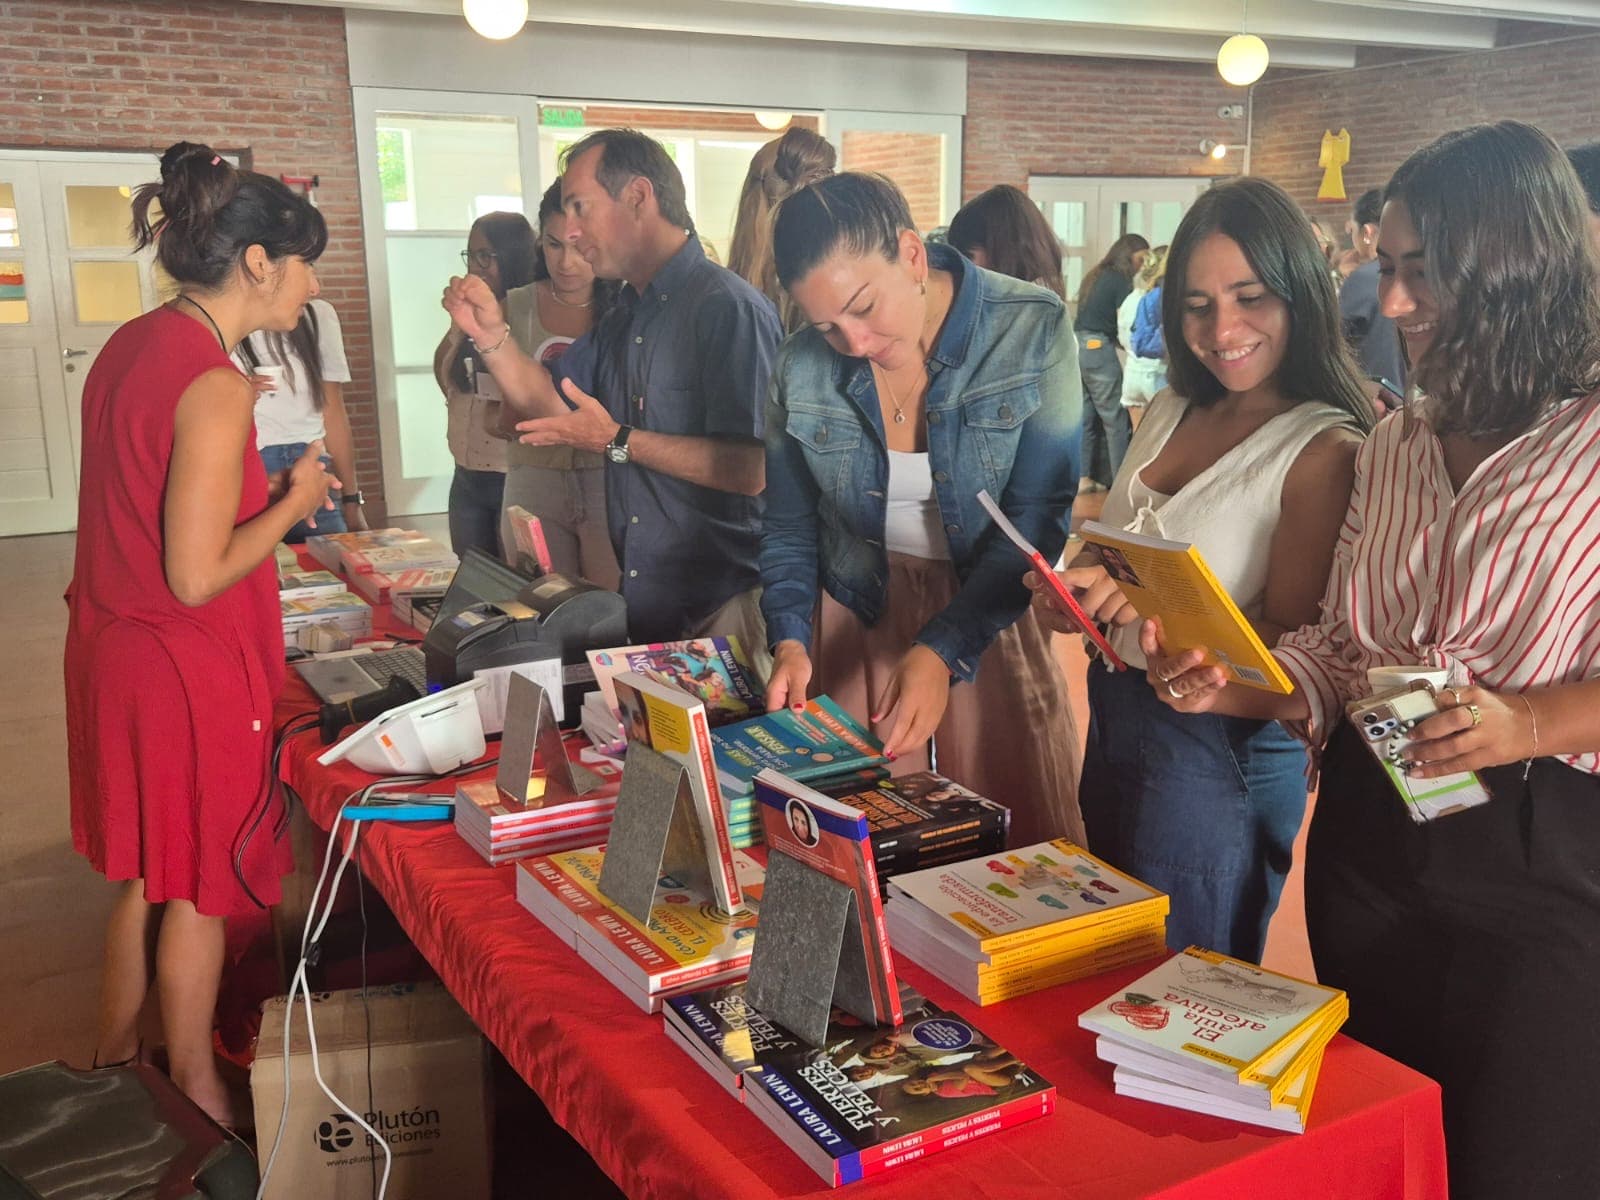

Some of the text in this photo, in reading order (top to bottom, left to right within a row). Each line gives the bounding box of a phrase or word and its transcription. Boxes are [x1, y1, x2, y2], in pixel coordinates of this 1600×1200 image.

[543, 108, 583, 123] SALIDA
[745, 726, 787, 754] PENSAR
[533, 862, 565, 885] LEWIN
[557, 883, 592, 908] LAURA
[939, 874, 1018, 924] transformada
[595, 913, 631, 940] LEWIN
[654, 910, 694, 936] CEREBRO
[627, 936, 664, 965] LAURA
[682, 1003, 715, 1032] LEWIN
[1163, 993, 1267, 1032] afectiva
[1183, 1012, 1233, 1034] aula
[1192, 1026, 1224, 1043] El
[797, 1065, 874, 1132] FUERTES
[812, 1059, 900, 1127] y FELICES
[364, 1106, 440, 1132] Plutón
[762, 1072, 842, 1146] LAURA LEWIN
